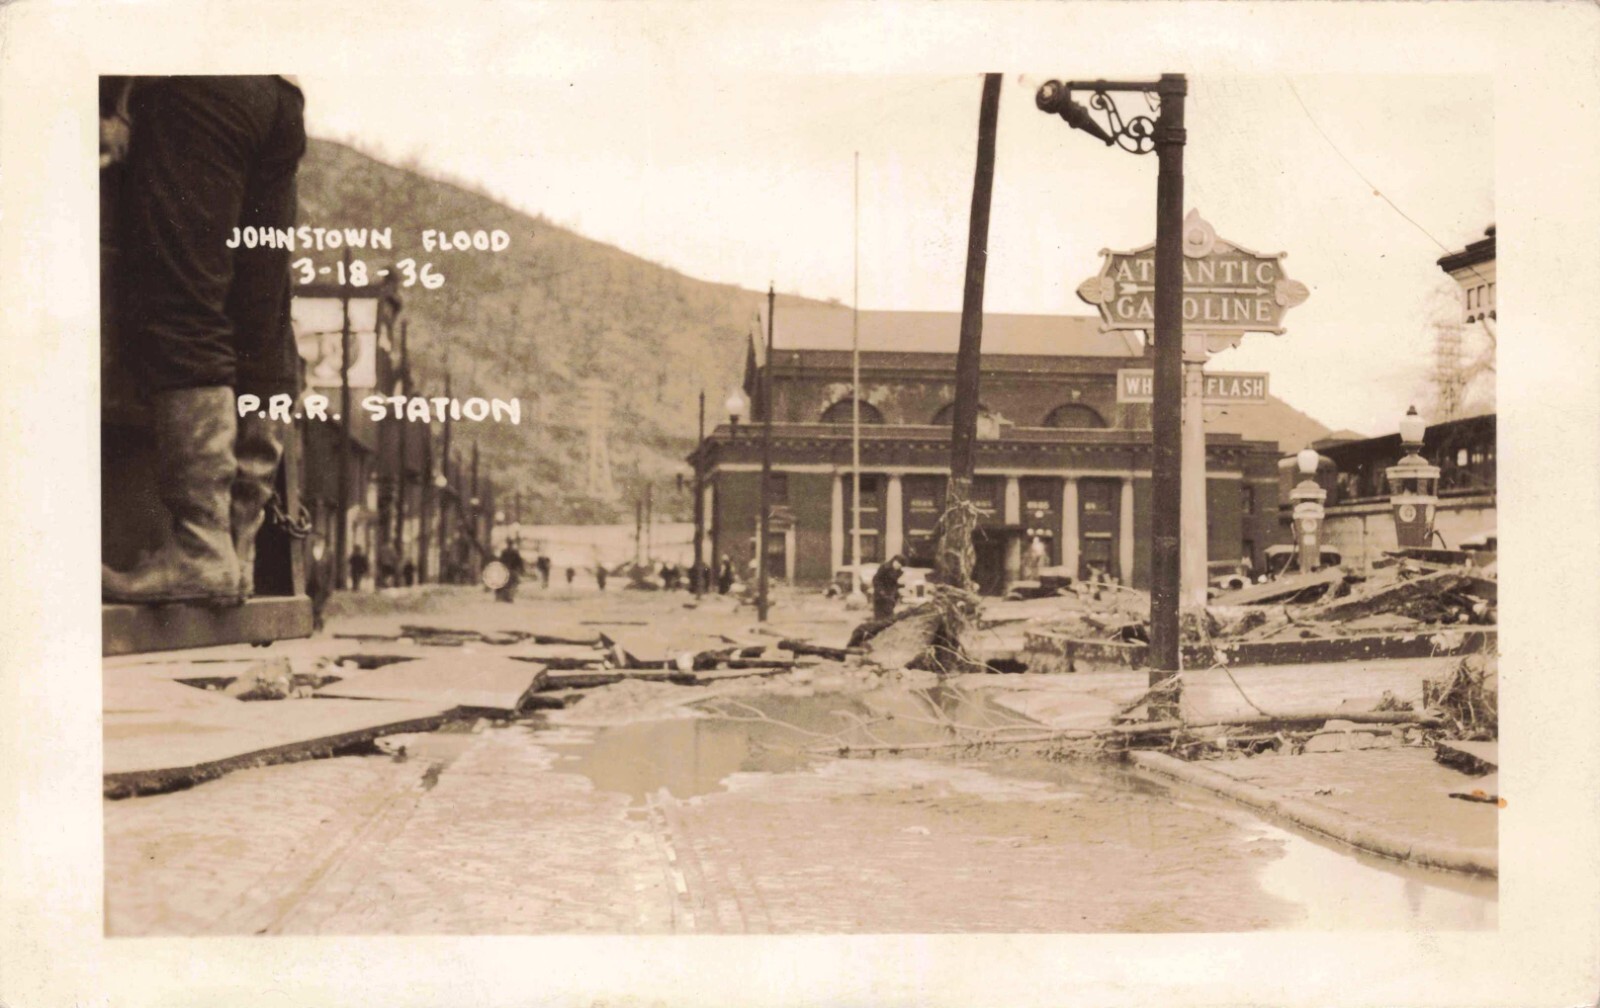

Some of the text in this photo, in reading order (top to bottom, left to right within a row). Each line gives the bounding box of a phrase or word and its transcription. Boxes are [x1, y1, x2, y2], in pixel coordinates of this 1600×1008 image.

[1117, 259, 1274, 283] ATANTIC
[1117, 297, 1272, 321] GAOLINE
[1207, 379, 1264, 396] FLASH
